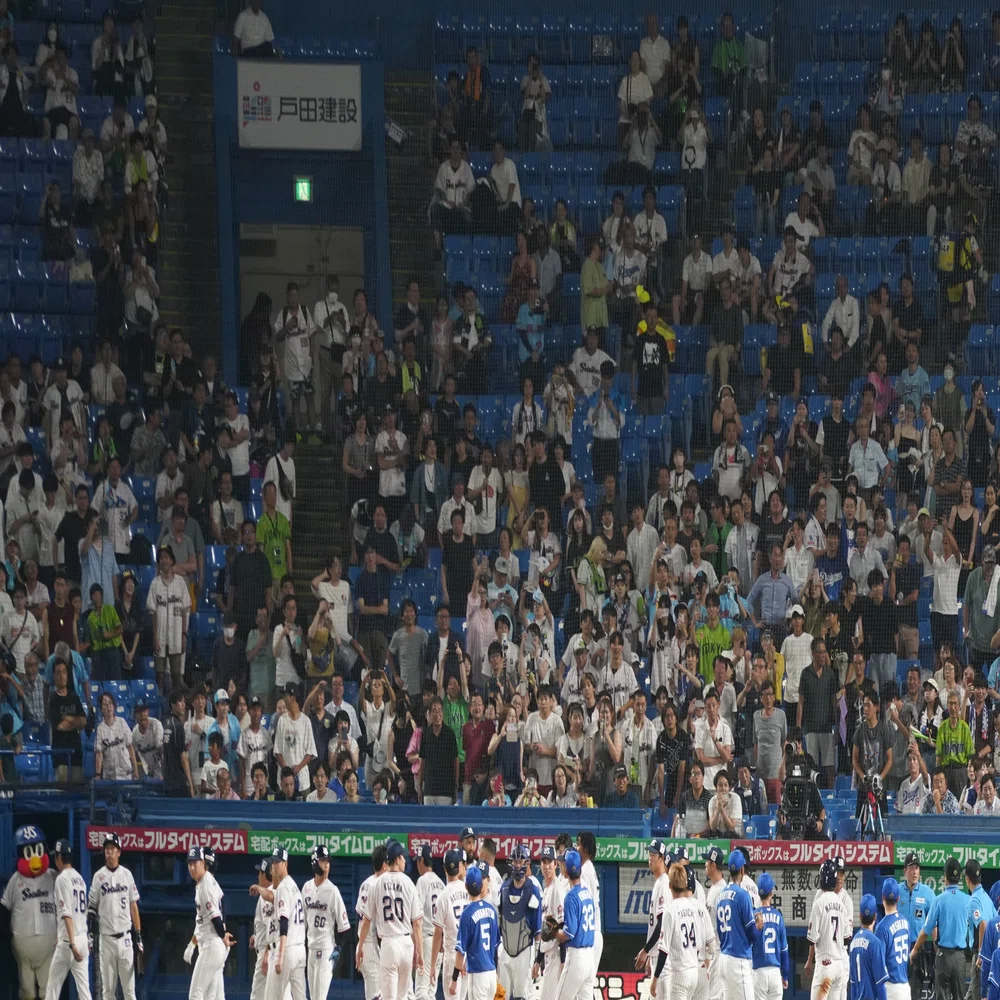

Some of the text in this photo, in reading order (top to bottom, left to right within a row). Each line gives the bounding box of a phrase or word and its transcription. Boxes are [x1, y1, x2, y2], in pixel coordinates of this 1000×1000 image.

[277, 96, 357, 124] 戸田建設
[120, 897, 127, 910] 5
[382, 895, 404, 923] 20
[581, 903, 596, 932] 32
[313, 914, 327, 928] 60
[717, 904, 732, 933] 92
[762, 913, 780, 925] ANAKA
[830, 916, 839, 943] 7
[480, 922, 491, 951] 5
[680, 922, 697, 949] 34
[764, 927, 777, 954] 2
[893, 933, 909, 965] 55
[856, 953, 861, 982] 1
